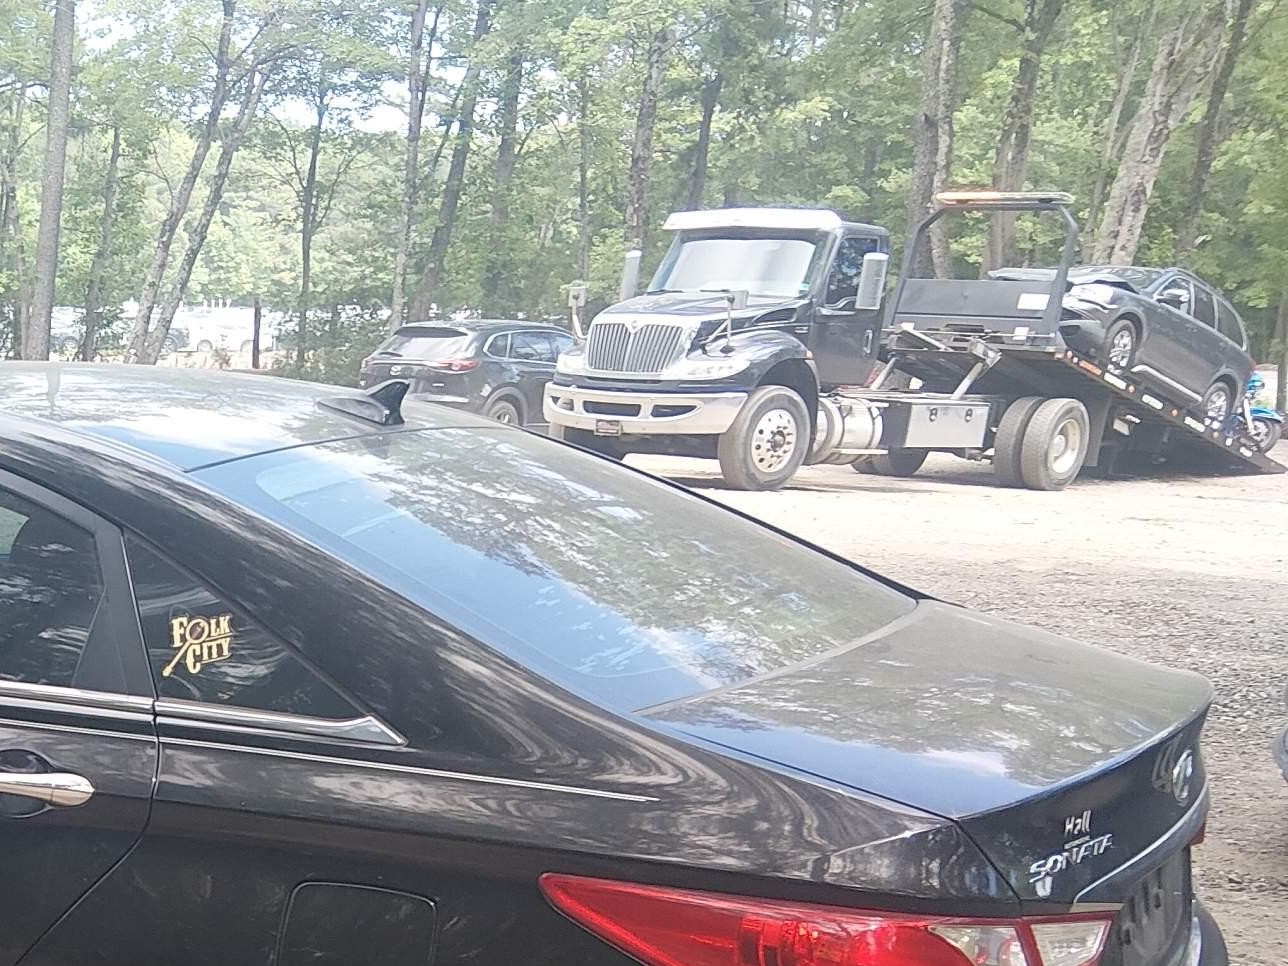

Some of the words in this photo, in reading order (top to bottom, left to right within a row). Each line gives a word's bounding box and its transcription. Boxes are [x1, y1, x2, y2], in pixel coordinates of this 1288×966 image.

[171, 615, 231, 648] FOLK
[186, 637, 232, 674] CITY
[1064, 809, 1092, 837] Hall
